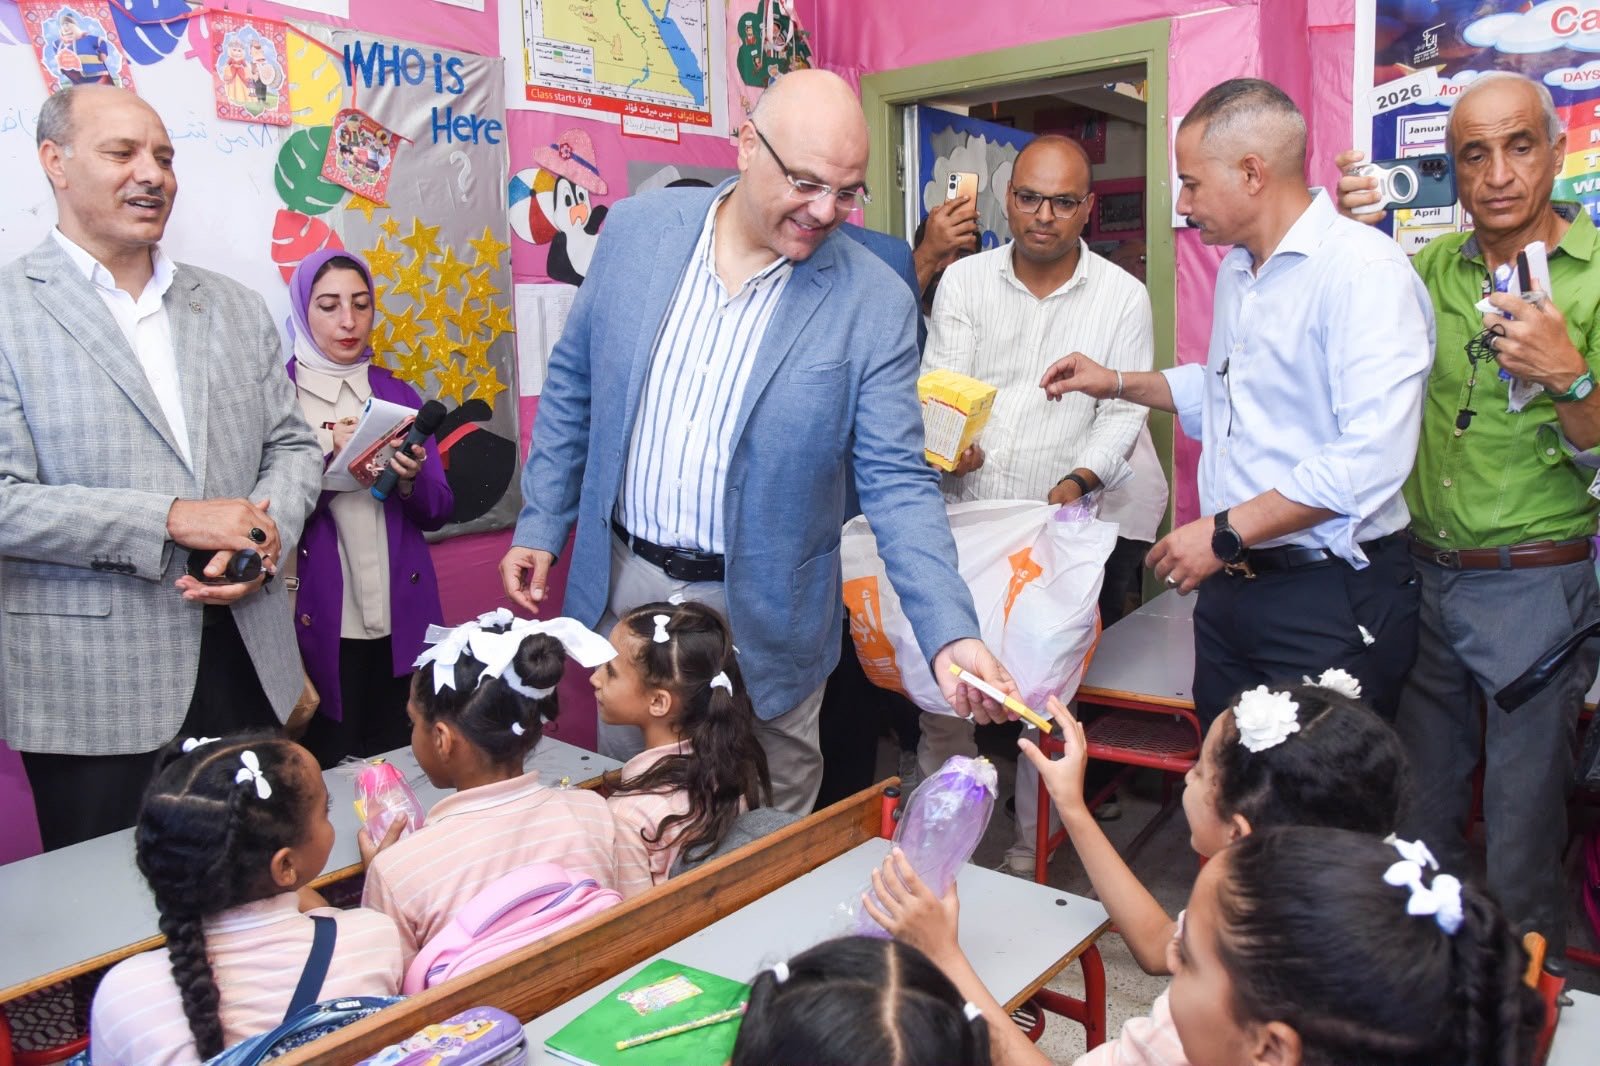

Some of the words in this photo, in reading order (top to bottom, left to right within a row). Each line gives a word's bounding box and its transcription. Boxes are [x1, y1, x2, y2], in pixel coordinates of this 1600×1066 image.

[343, 40, 425, 88] WHO
[531, 88, 553, 101] Class
[554, 91, 576, 104] starts
[577, 96, 592, 108] Kg2
[1376, 84, 1422, 110] 2026
[431, 107, 503, 145] Here
[1414, 208, 1441, 218] April
[1414, 236, 1434, 245] Ma
